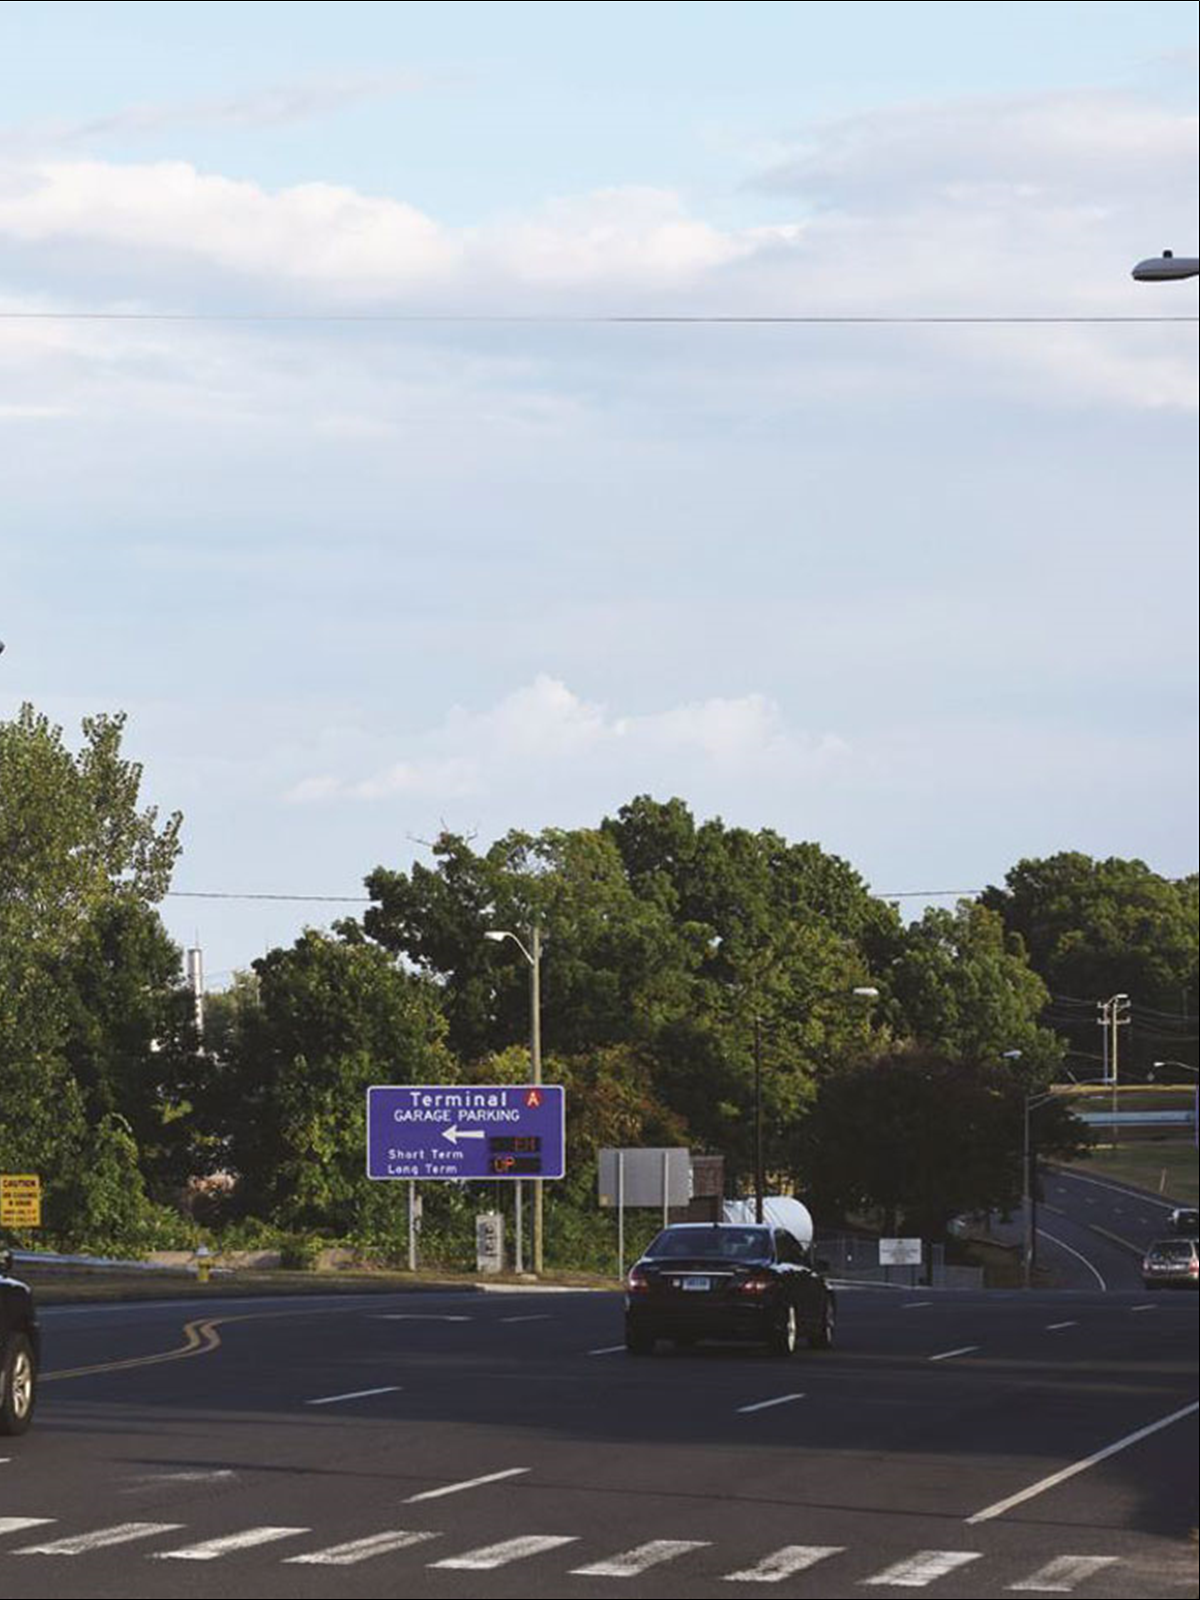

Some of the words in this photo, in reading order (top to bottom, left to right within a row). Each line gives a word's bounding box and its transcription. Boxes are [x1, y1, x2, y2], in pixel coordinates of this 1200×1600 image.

[410, 1091, 506, 1107] Terminal
[527, 1091, 539, 1106] A
[394, 1109, 451, 1122] GARAGE
[458, 1109, 520, 1122] PARKING
[388, 1149, 424, 1160] Short
[432, 1149, 464, 1160] Term
[388, 1164, 419, 1175] Long
[425, 1163, 458, 1174] Term
[3, 1180, 36, 1188] CAUTION
